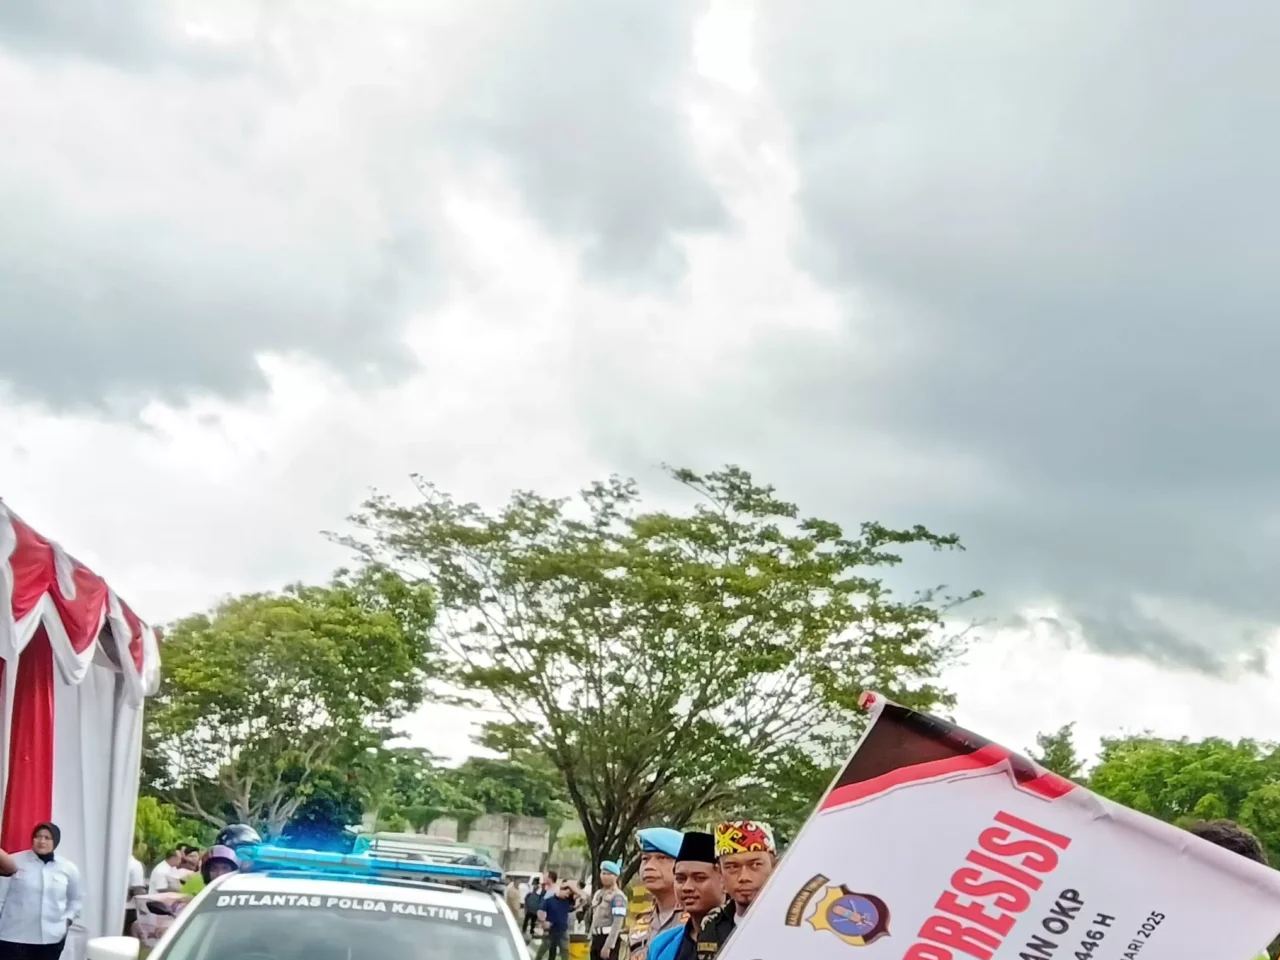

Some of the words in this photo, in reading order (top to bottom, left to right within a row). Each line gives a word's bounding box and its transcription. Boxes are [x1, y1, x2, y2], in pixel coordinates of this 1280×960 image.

[216, 894, 321, 908] DITLANTAS
[327, 897, 387, 913] POLDA
[392, 903, 459, 921] KALTIM
[1042, 888, 1085, 935] OKP
[1093, 912, 1116, 928] H
[1137, 910, 1167, 939] 2025
